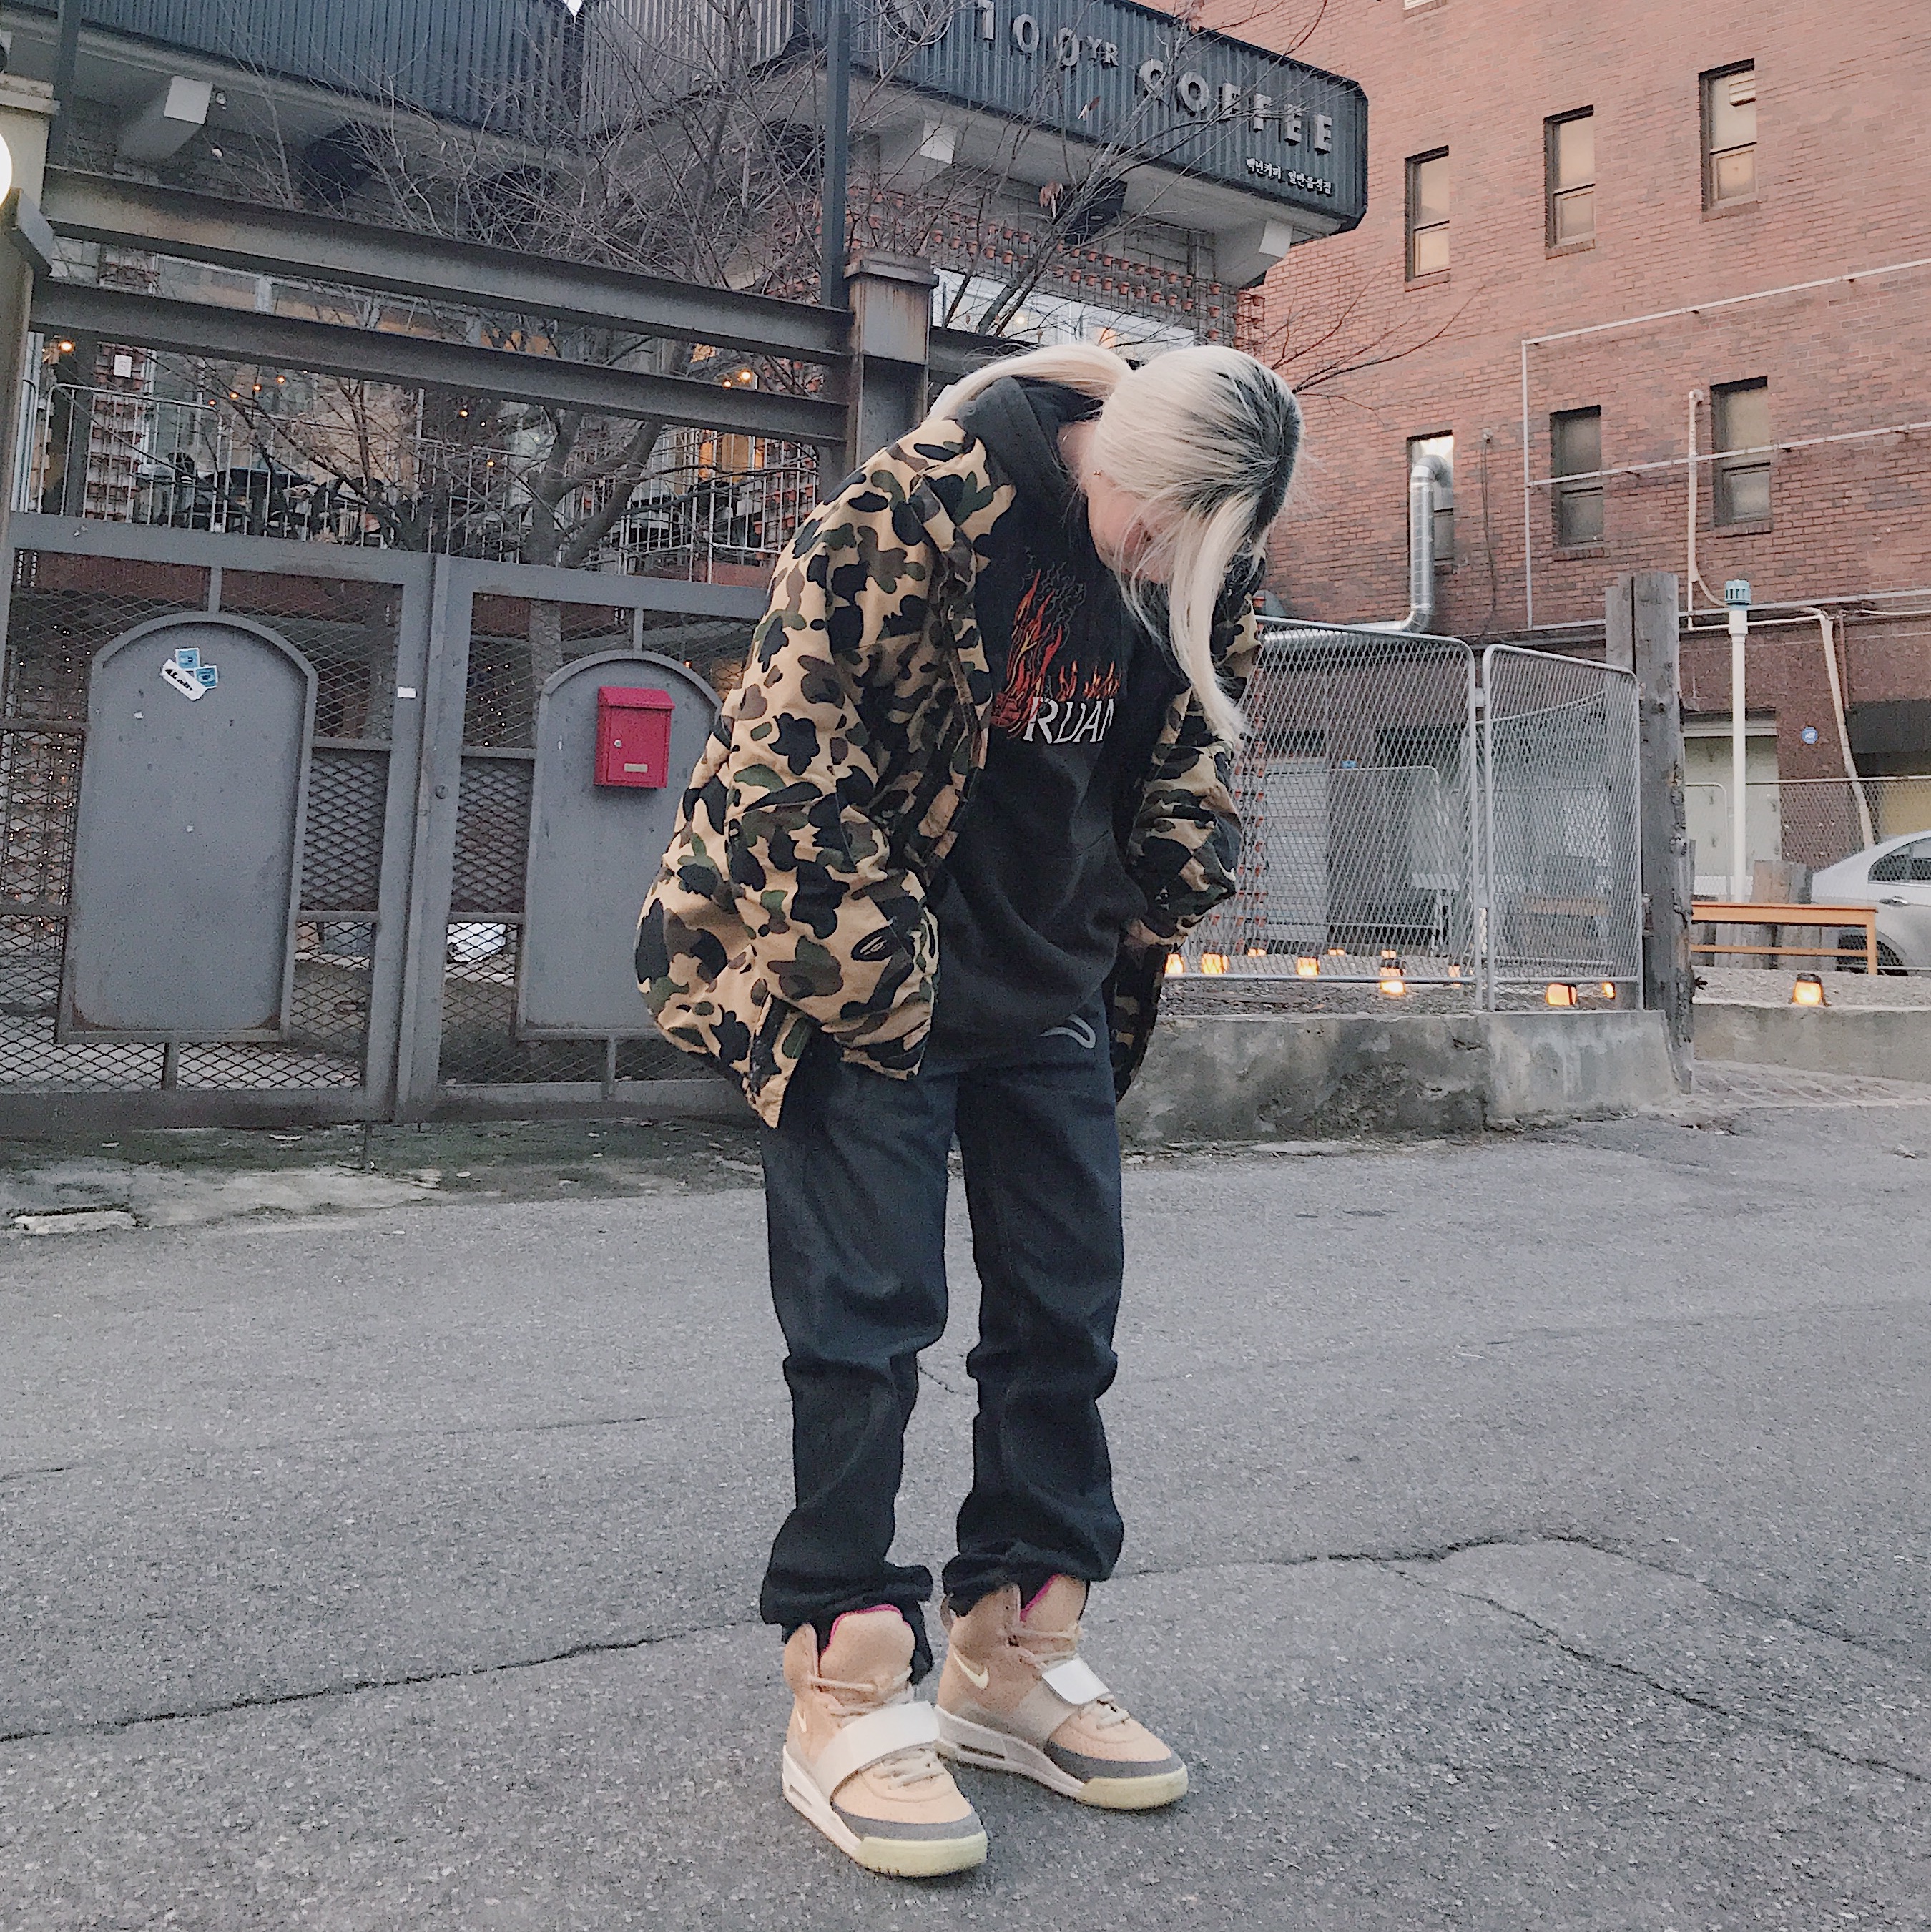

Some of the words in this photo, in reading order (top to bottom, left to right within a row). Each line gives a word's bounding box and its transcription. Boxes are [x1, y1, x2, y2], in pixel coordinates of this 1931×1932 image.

[1139, 57, 1332, 152] COFFEE
[1246, 157, 1282, 180] 백년커피
[1287, 170, 1331, 195] 일반음식점
